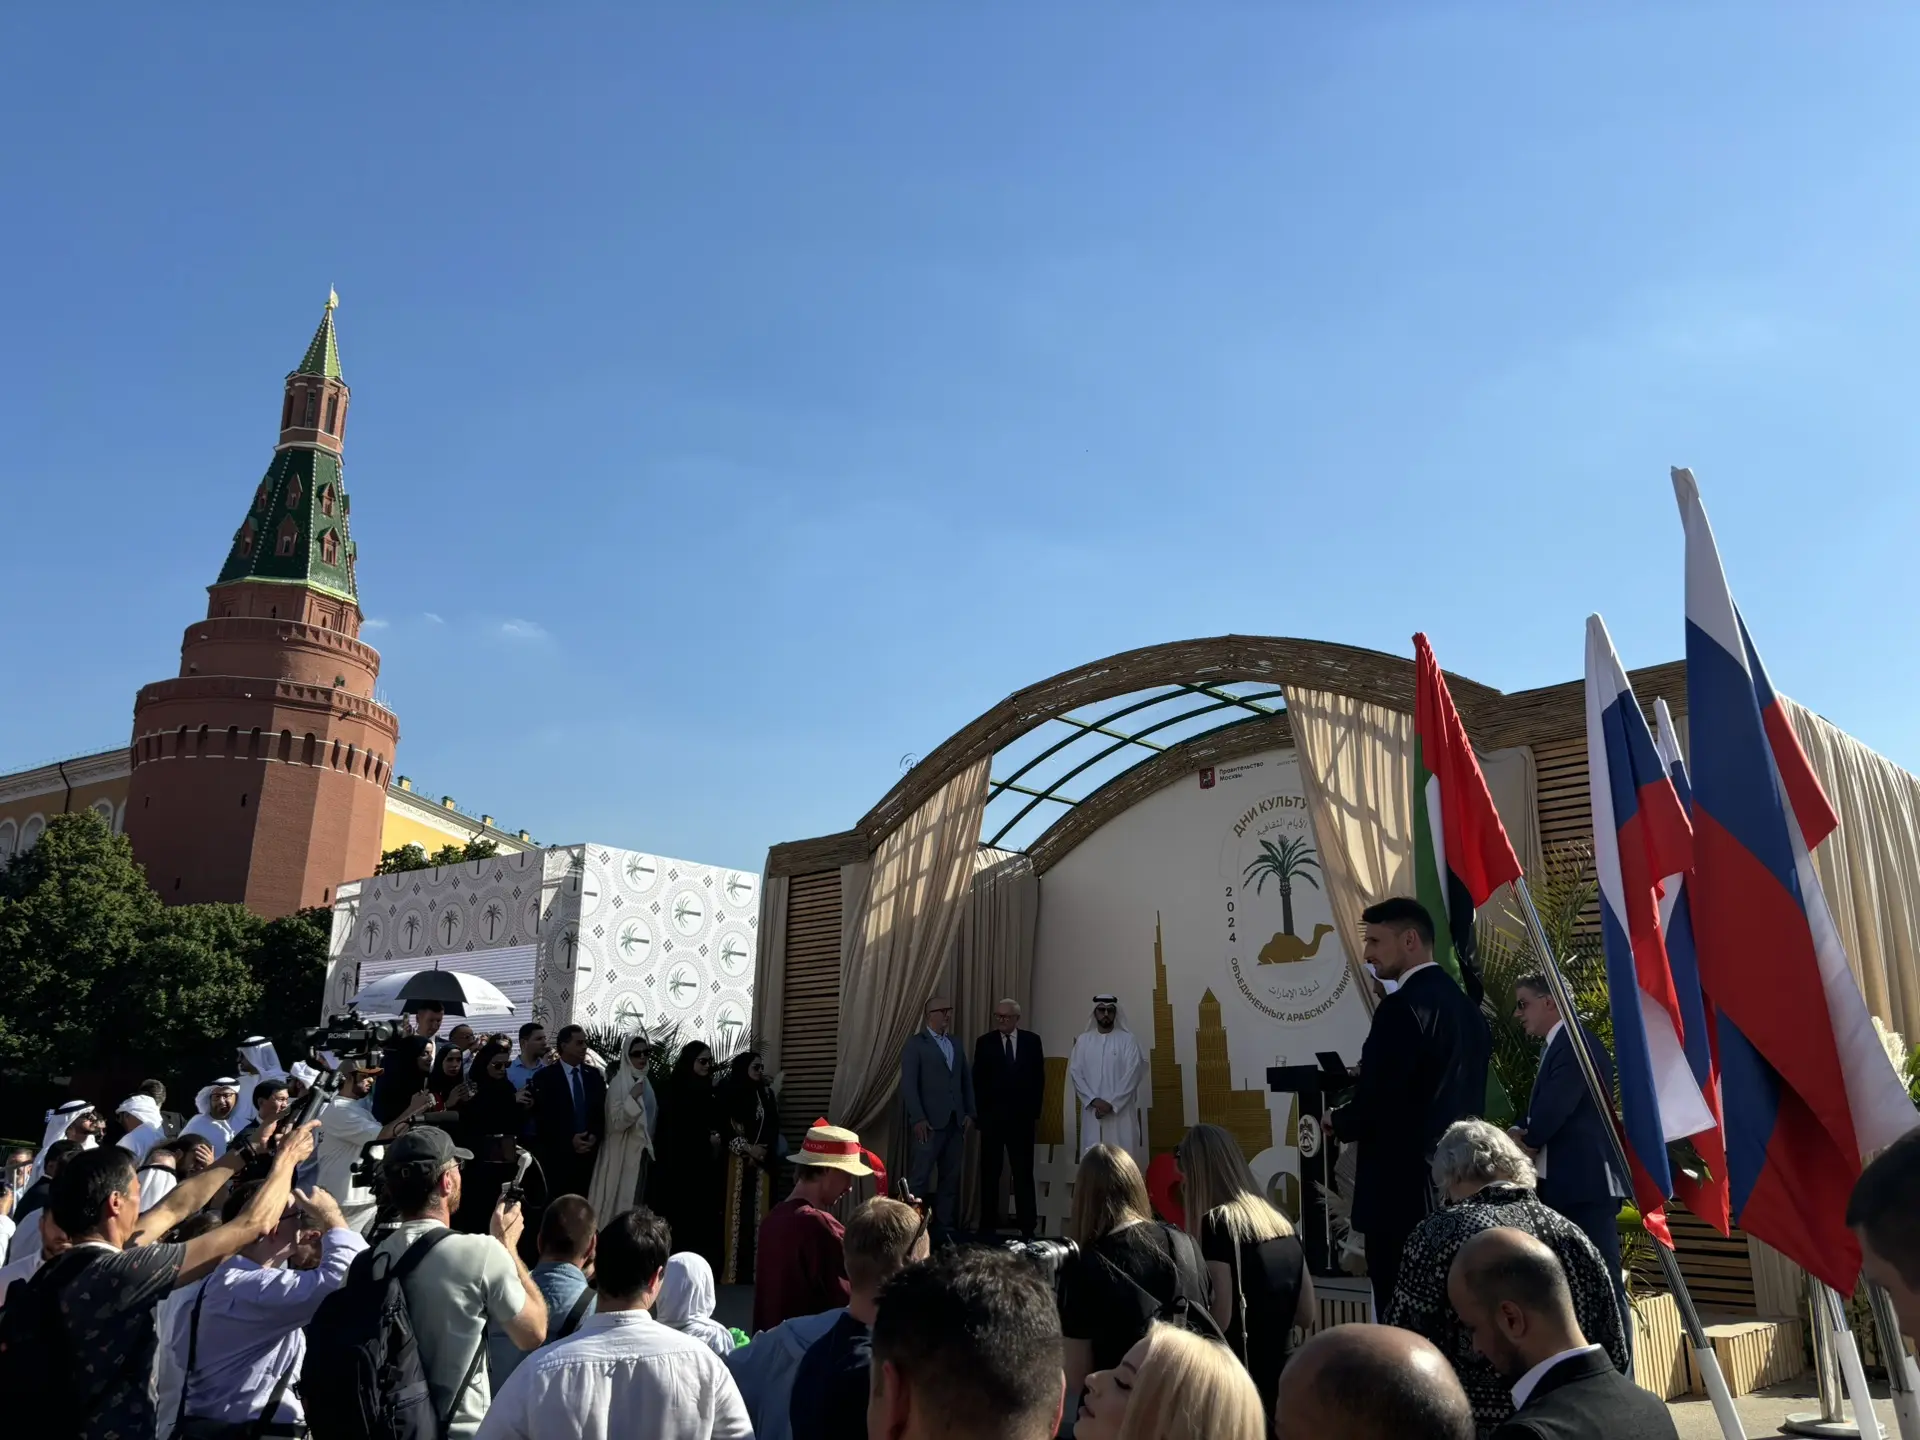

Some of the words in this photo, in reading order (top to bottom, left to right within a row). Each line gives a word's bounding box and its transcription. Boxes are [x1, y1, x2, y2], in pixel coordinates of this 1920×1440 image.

[1219, 761, 1264, 775] Правительство
[1219, 773, 1243, 782] Москвы
[1233, 807, 1259, 838] ДНИ
[1225, 886, 1236, 943] 2024
[1231, 957, 1286, 1021] ОБЪЕДИНЕННЫХ
[1286, 997, 1336, 1022] АРАБСКИХ
